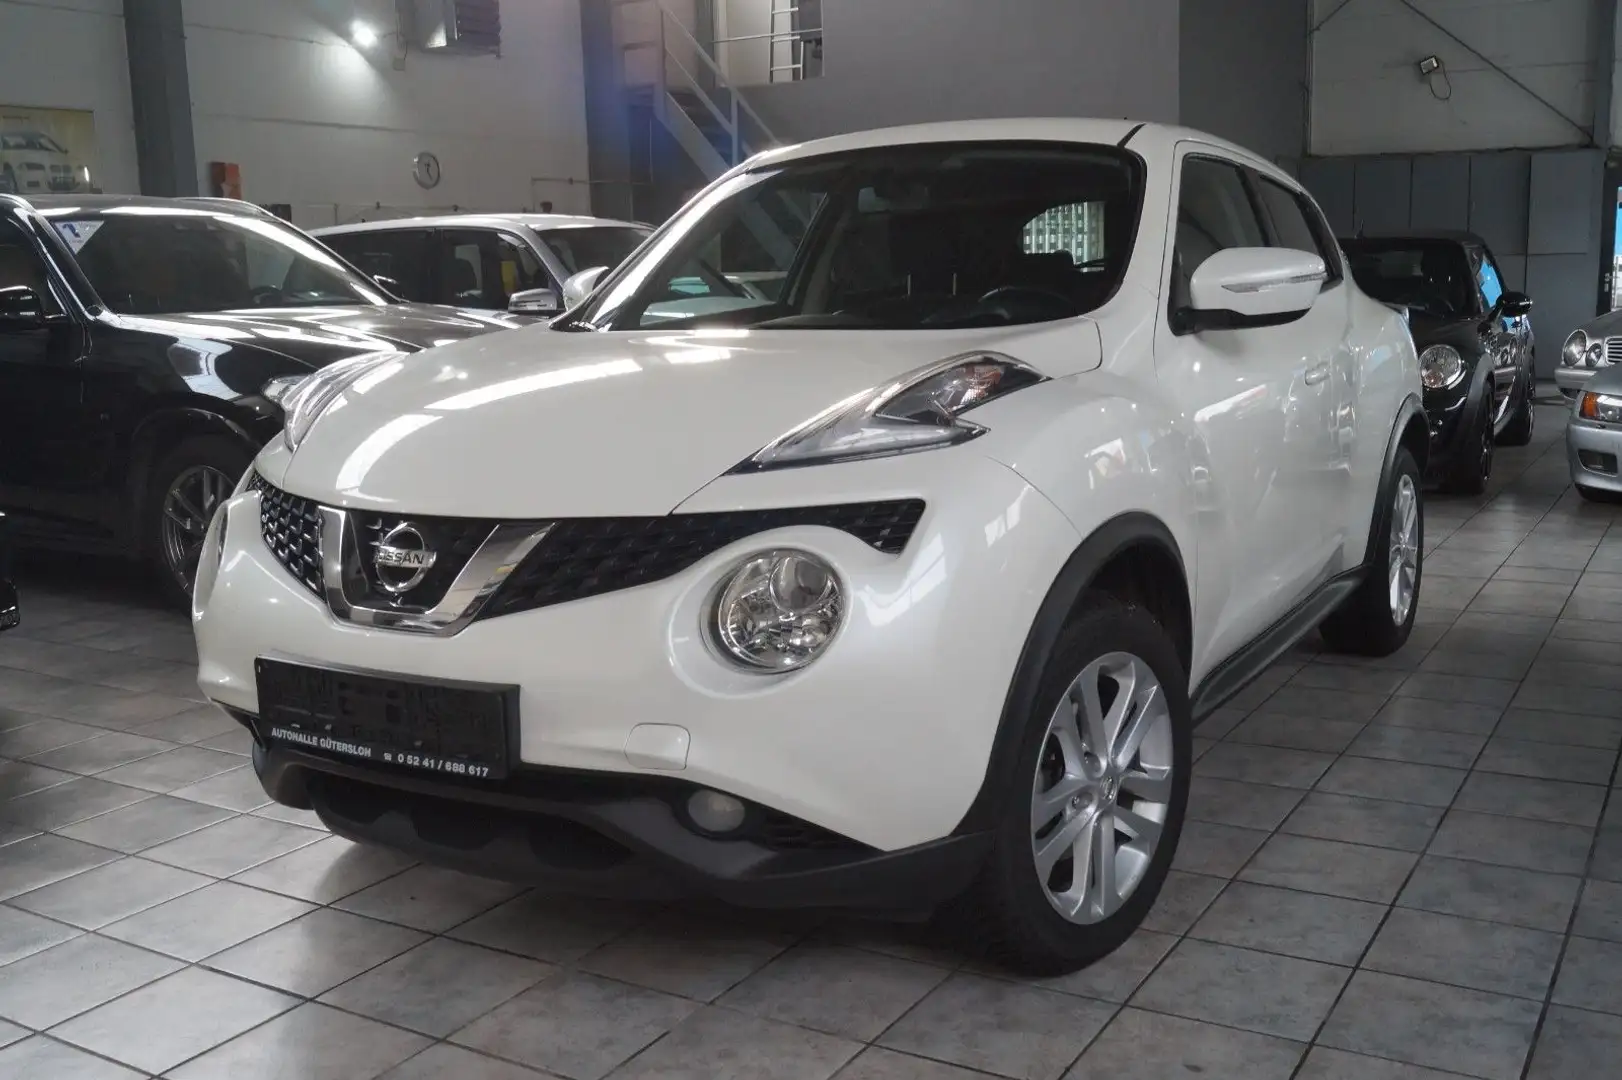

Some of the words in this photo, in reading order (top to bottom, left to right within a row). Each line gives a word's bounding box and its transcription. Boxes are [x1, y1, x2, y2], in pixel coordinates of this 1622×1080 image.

[271, 727, 318, 746] AUTOHALLE
[320, 736, 372, 757] GÜTERSLOH
[397, 753, 405, 763] 0
[406, 755, 420, 766] 52
[422, 757, 434, 769] 41
[468, 765, 489, 777] 617
